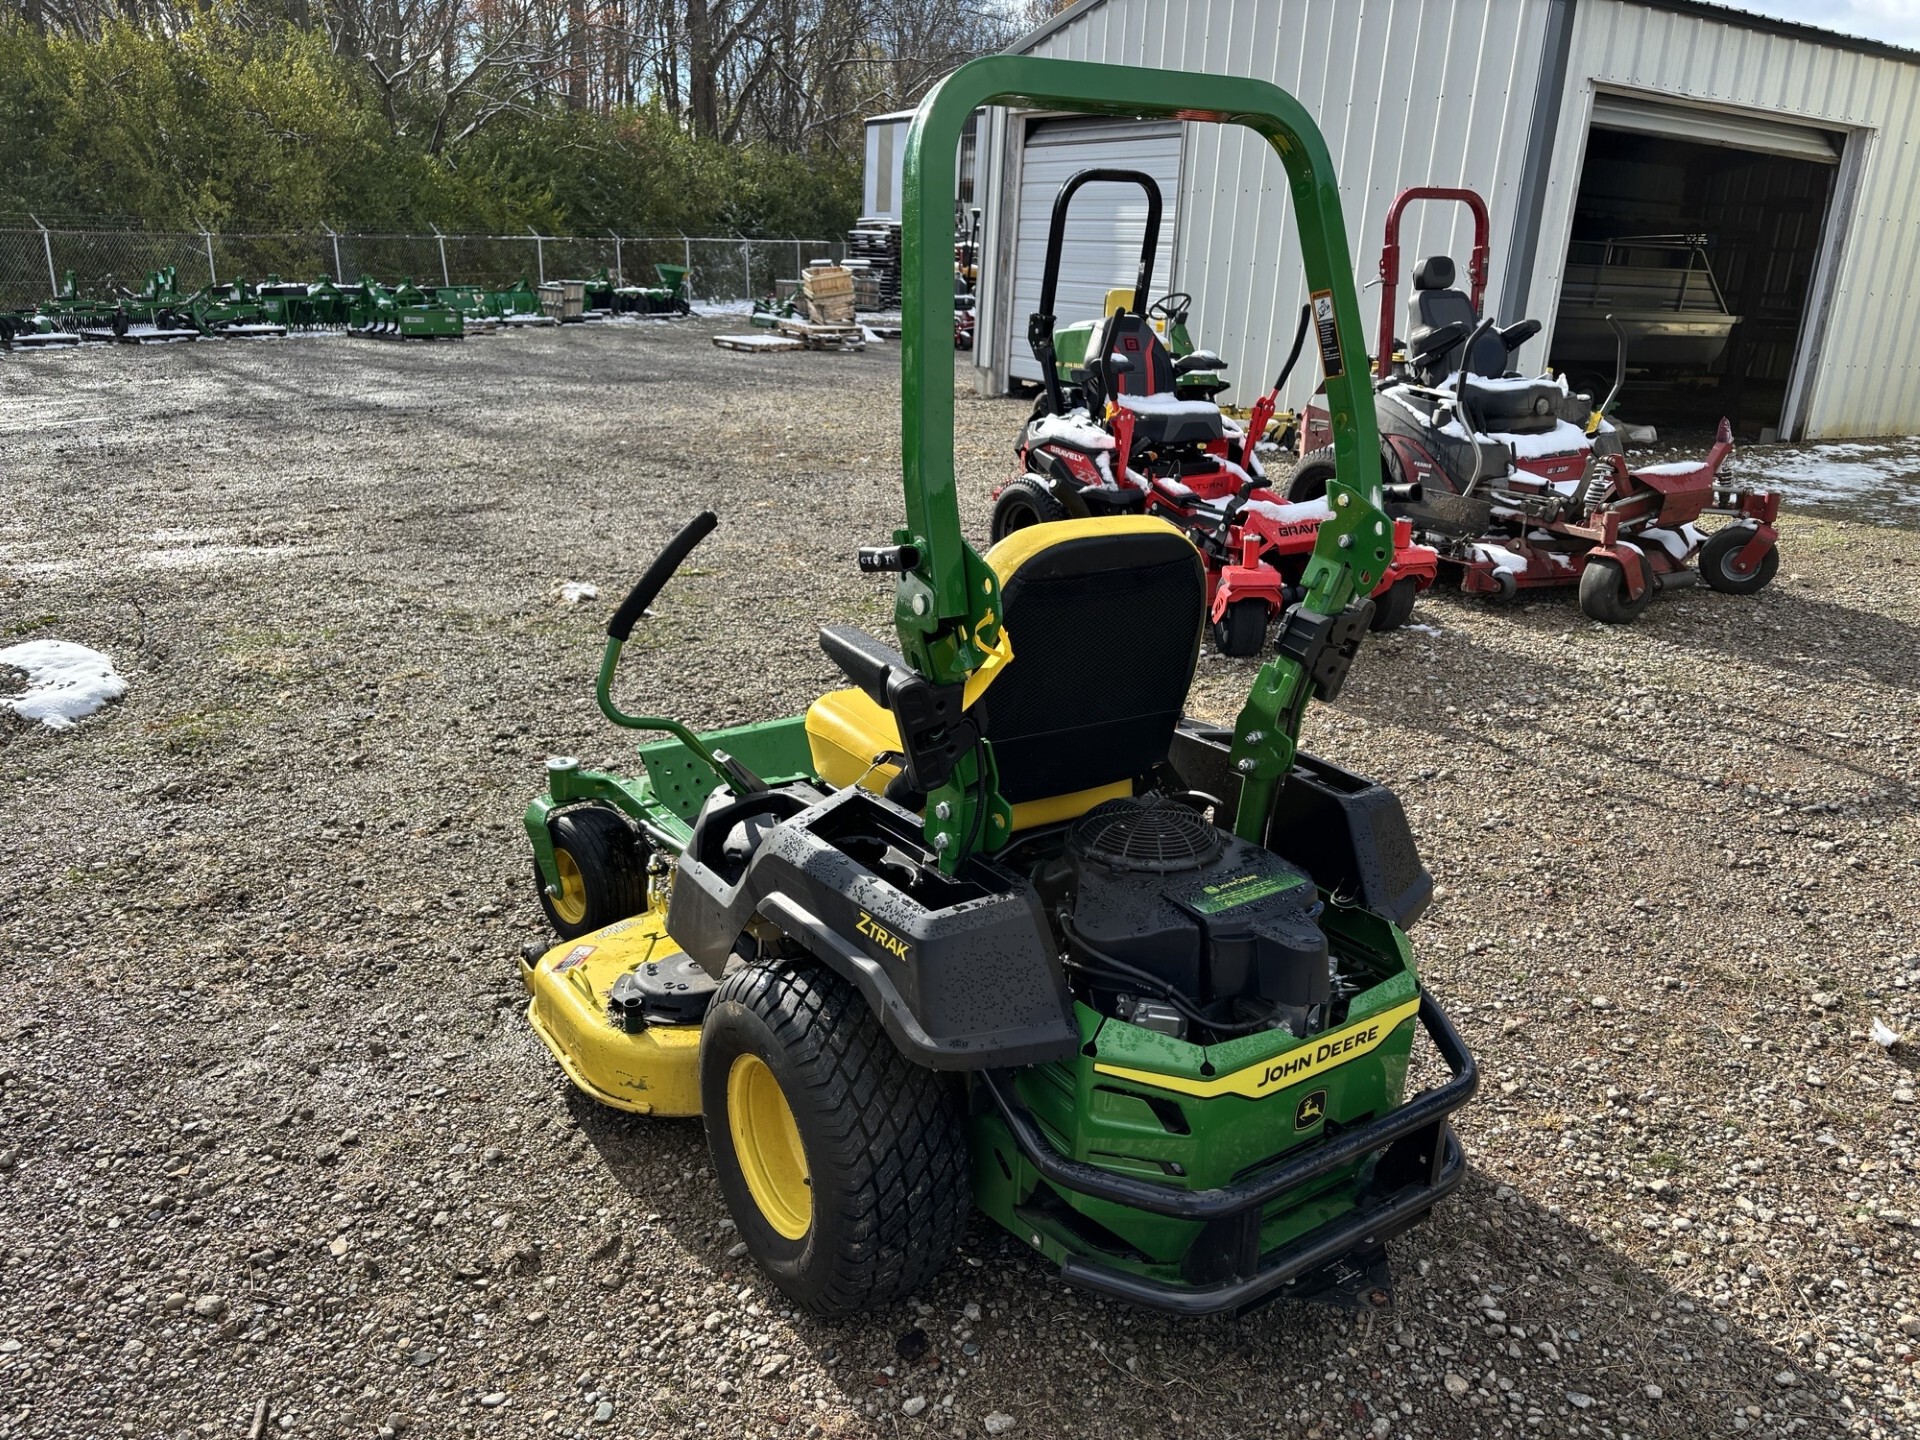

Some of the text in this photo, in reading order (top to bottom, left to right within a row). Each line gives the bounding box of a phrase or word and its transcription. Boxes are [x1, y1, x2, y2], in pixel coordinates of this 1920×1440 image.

[1050, 445, 1085, 462] GRAVELY
[855, 911, 910, 961] ZTRAK
[1257, 1025, 1380, 1089] JOHN DEERE
